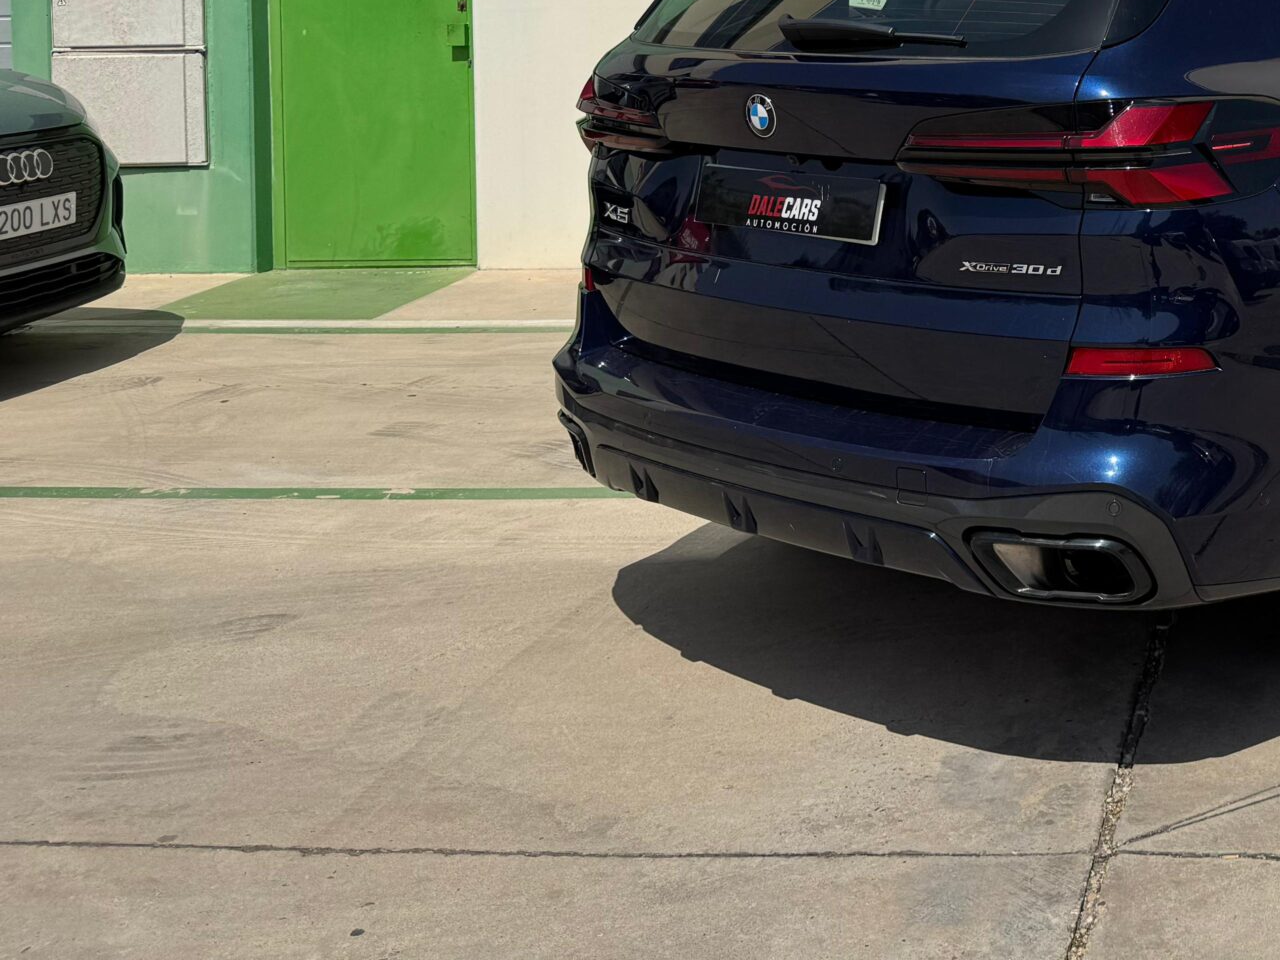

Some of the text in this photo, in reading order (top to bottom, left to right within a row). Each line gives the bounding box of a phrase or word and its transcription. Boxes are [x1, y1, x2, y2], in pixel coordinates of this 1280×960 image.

[40, 197, 72, 227] LXS
[604, 201, 629, 224] X5
[748, 194, 822, 222] DALECARS
[746, 218, 818, 234] AUTOMOCIÓN
